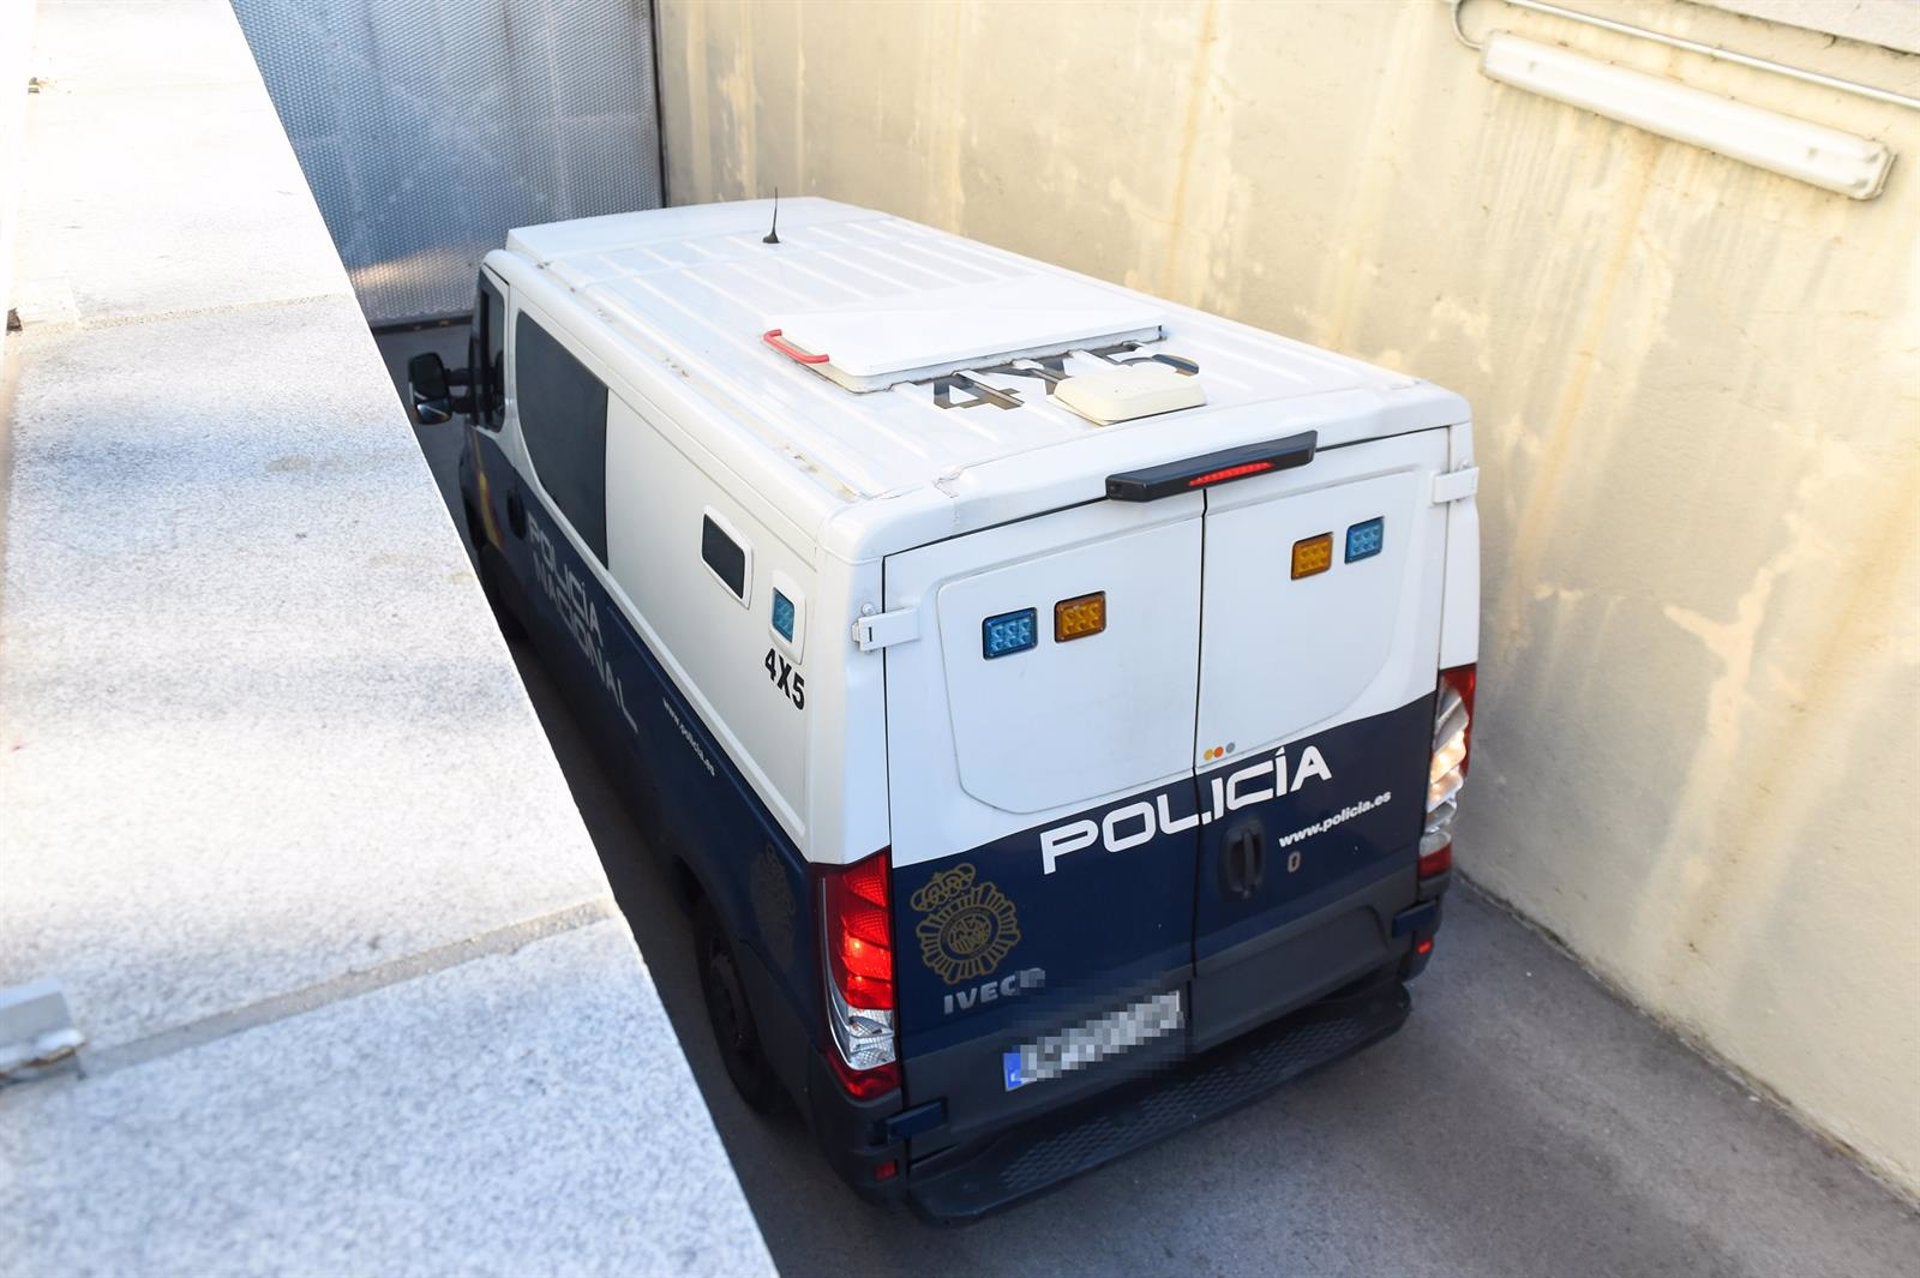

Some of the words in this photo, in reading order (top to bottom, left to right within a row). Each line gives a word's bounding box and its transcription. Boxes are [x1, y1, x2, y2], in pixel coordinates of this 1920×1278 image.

[532, 551, 639, 734] NACIONAL
[765, 648, 805, 710] 4X5
[1040, 746, 1332, 875] POLICÍA
[1278, 791, 1392, 848] www.policia.es
[944, 967, 1046, 1014] IVEC
